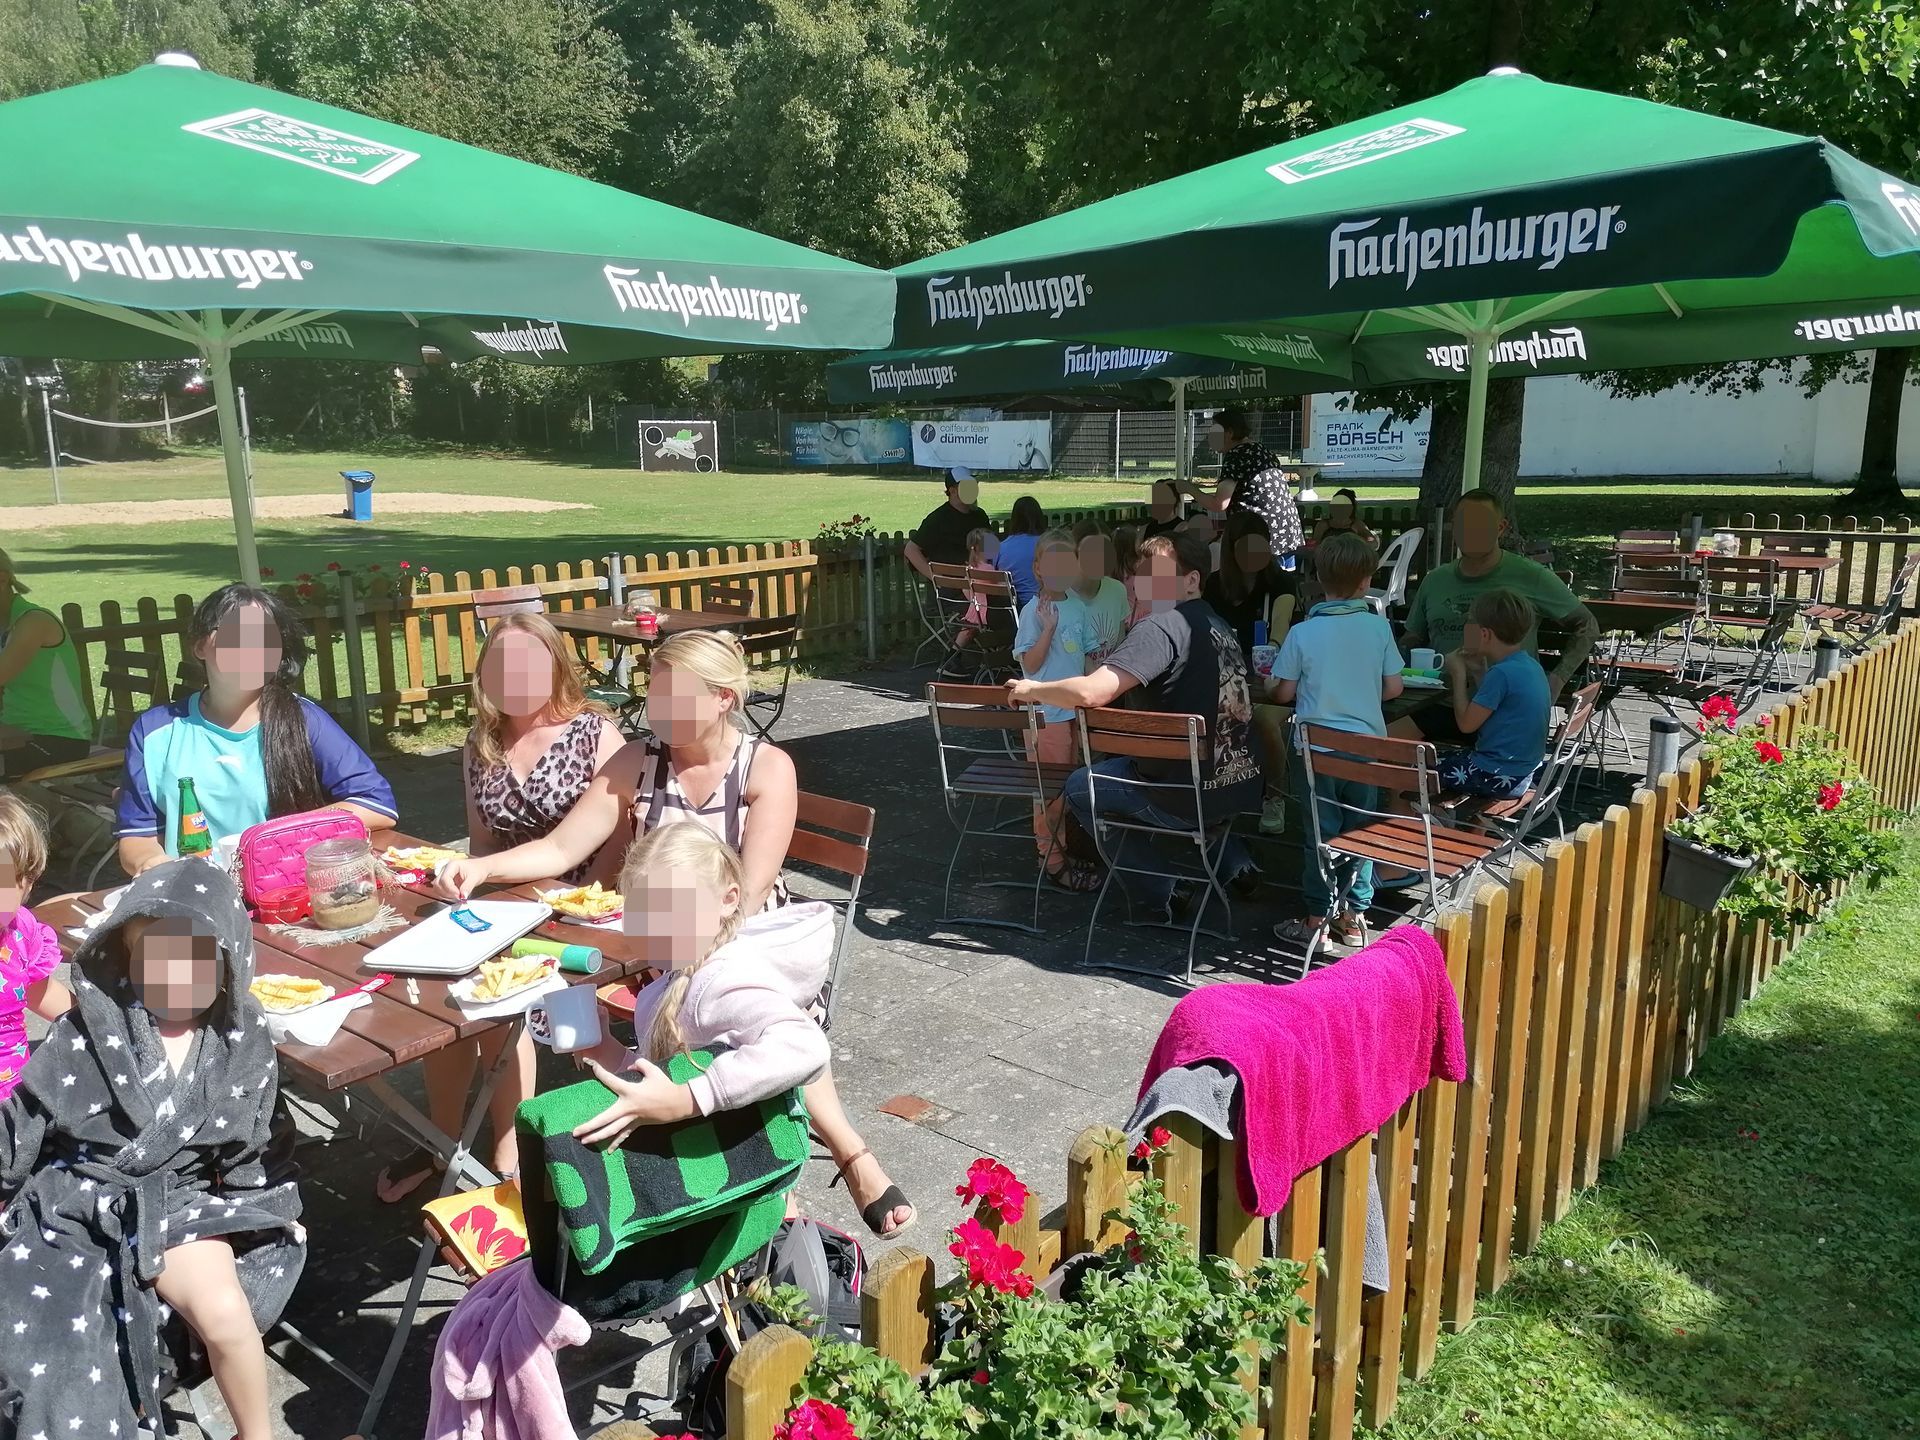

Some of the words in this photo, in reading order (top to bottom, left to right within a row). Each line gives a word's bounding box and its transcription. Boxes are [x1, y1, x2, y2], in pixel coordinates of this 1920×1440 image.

[0, 225, 304, 289] achenburger
[940, 423, 969, 433] coiffeur
[970, 424, 990, 433] team
[1327, 422, 1364, 431] FRANK
[940, 433, 989, 445] dümmler
[1327, 431, 1404, 446] BÖRSCH
[1202, 779, 1218, 791] BY
